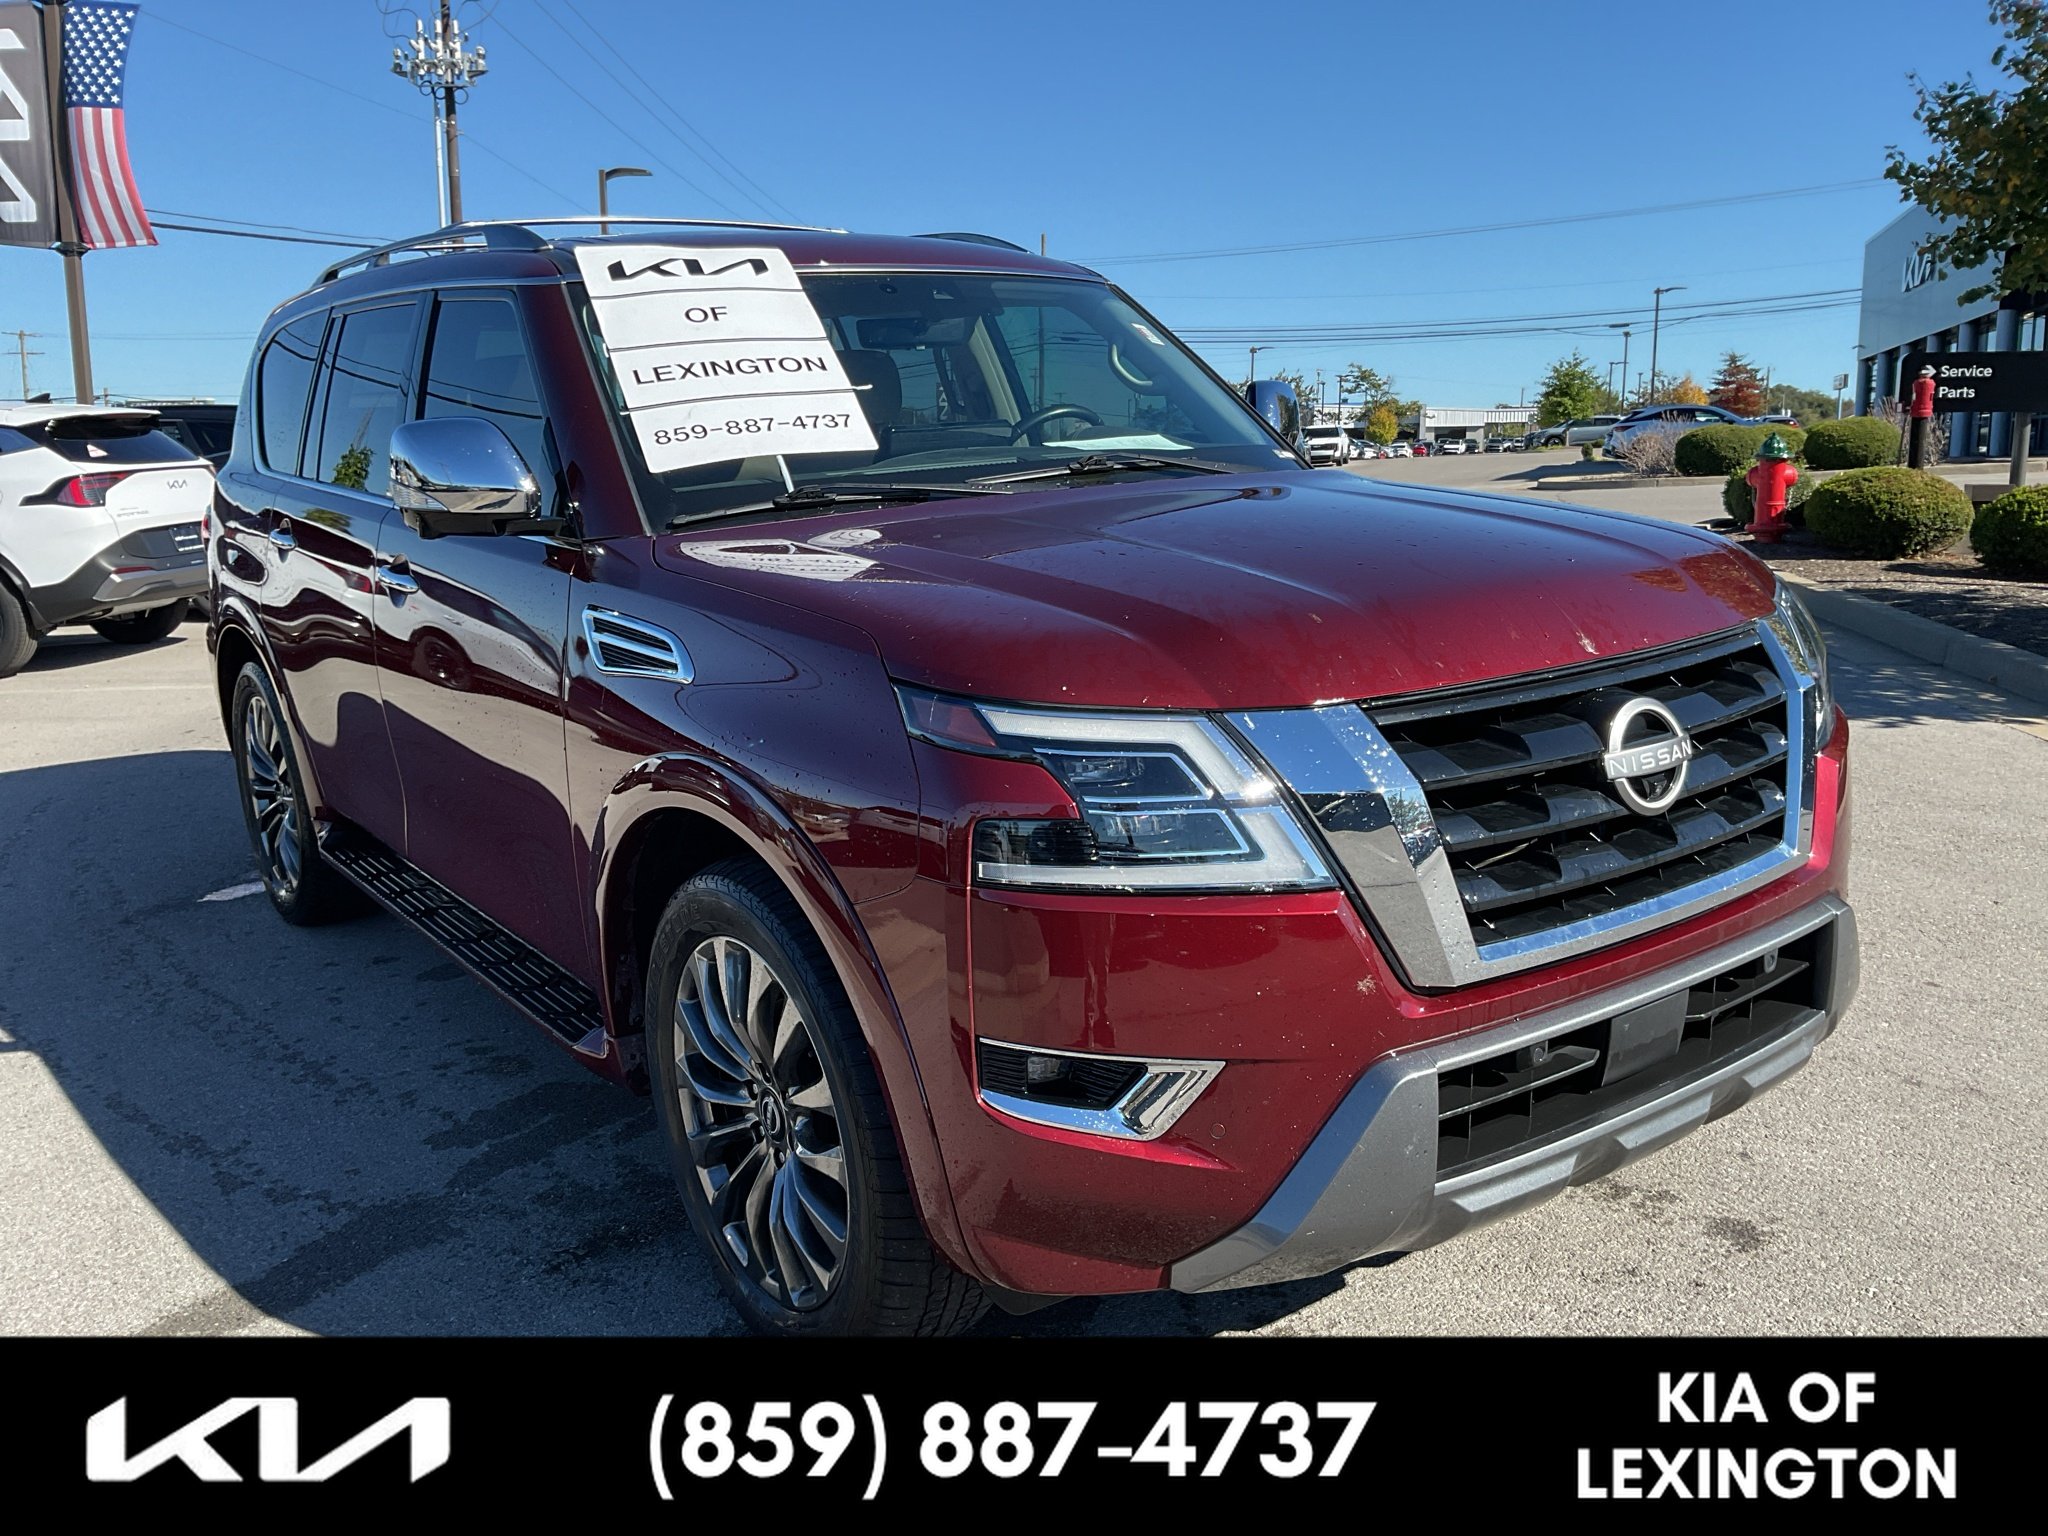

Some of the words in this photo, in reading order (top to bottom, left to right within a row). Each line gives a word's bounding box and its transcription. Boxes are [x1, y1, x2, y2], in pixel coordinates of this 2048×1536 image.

[607, 258, 769, 281] KIA
[684, 306, 728, 323] OF
[632, 357, 828, 385] LEXINGTON
[1940, 365, 1993, 378] Service
[1938, 386, 1976, 399] Parts
[654, 413, 851, 445] 859-887-4737
[1609, 739, 1692, 776] NISSAN
